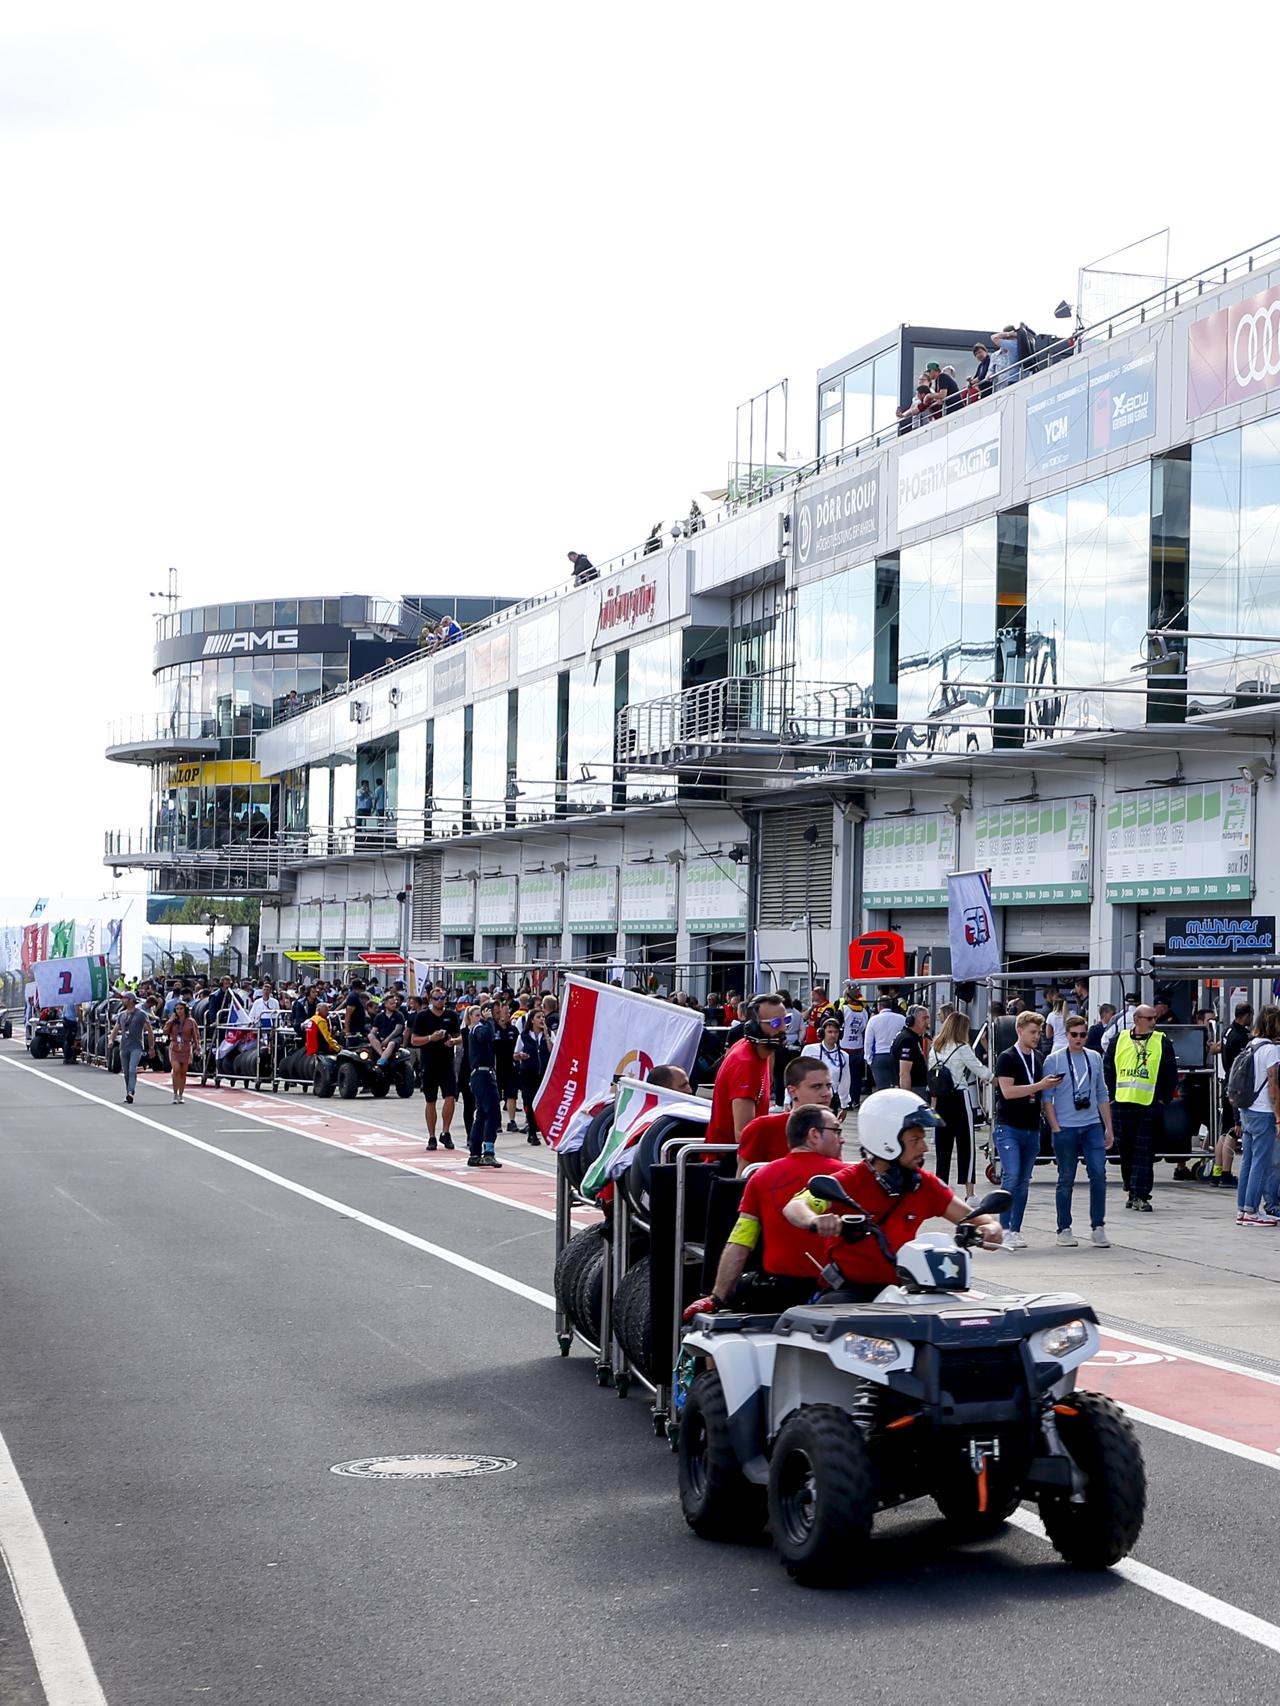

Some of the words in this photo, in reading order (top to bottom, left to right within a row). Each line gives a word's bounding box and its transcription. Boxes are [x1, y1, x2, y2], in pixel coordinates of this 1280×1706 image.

[844, 479, 877, 516] GROUP
[224, 629, 299, 652] AMG
[1185, 918, 1259, 934] mühlner
[1168, 933, 1273, 952] motorsport
[58, 970, 74, 995] 1
